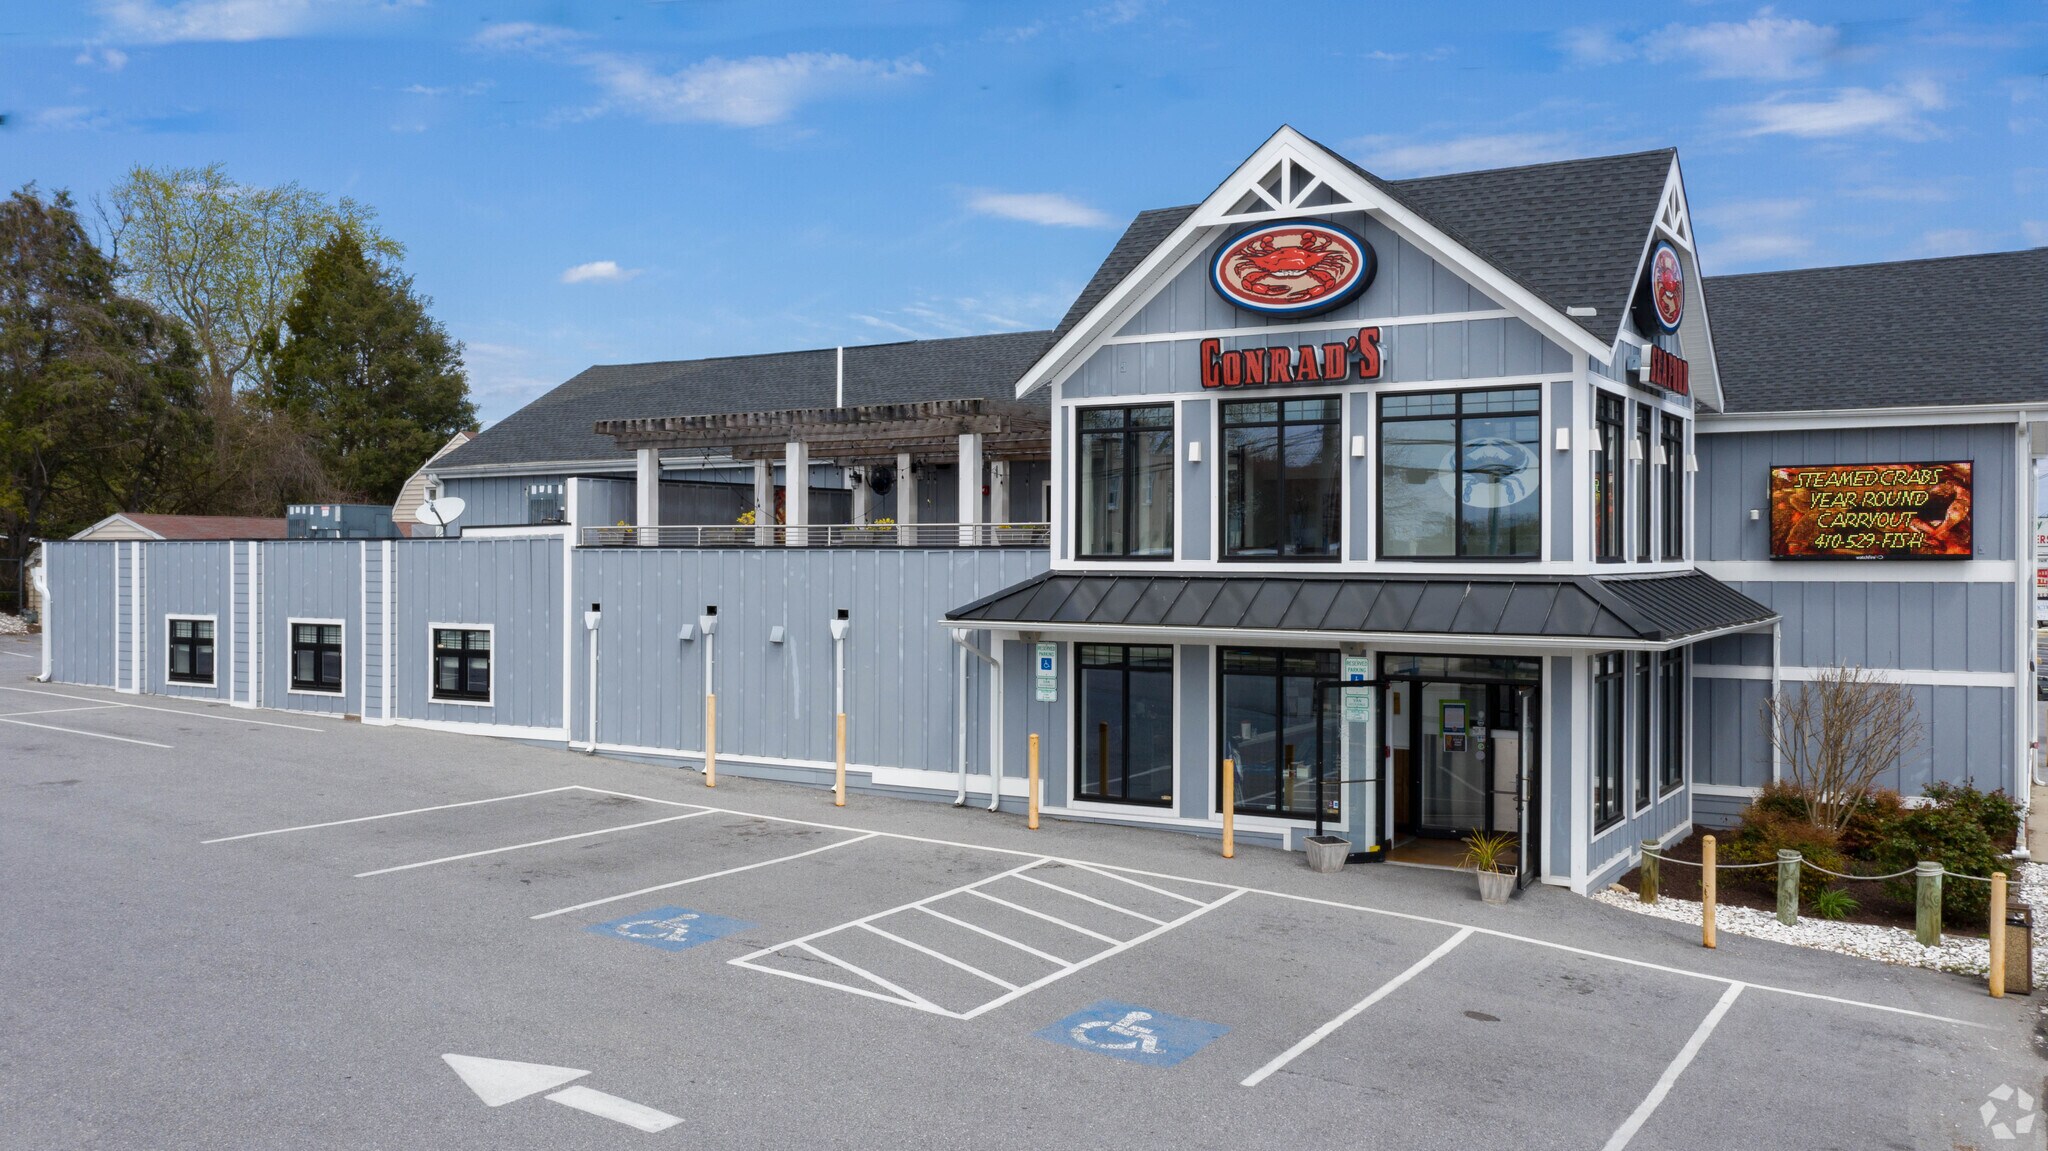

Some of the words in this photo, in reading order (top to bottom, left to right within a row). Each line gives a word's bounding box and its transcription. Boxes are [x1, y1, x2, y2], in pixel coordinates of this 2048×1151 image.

[1200, 326, 1382, 388] CONRAD'S
[1793, 471, 1878, 488] STEAMED
[1880, 469, 1943, 485] CRABS
[1810, 491, 1857, 509] YEAR
[1862, 490, 1929, 507] ROUND
[1817, 511, 1918, 528] CARRYOUT
[1814, 533, 1924, 548] 410-529-FISH
